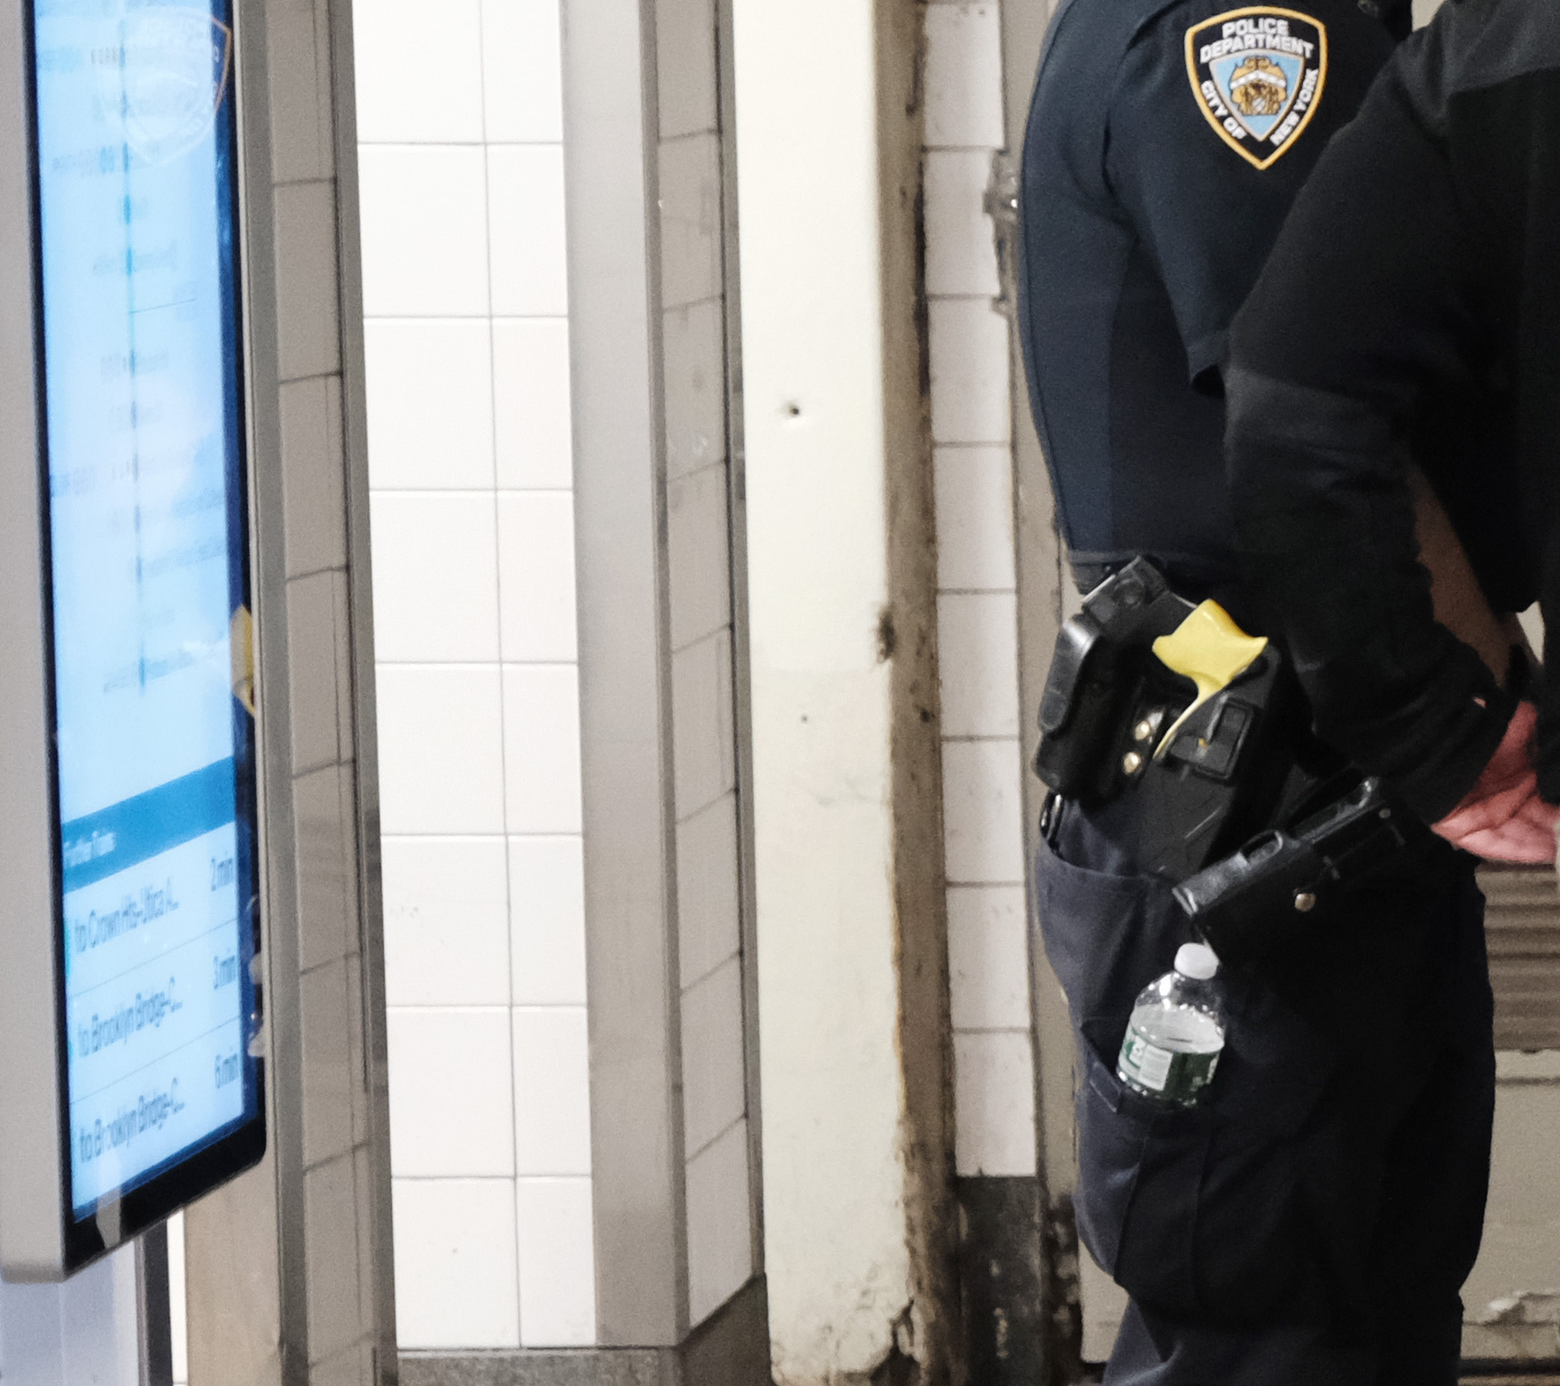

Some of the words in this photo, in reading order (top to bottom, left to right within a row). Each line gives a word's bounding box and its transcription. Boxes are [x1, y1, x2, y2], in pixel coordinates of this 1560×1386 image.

[1199, 33, 1315, 64] DEPARTMENT
[1221, 17, 1290, 39] POLICE
[1200, 79, 1229, 117] CITY
[1222, 116, 1249, 140] OF
[1269, 110, 1301, 147] NEW
[1293, 68, 1320, 112] YORK
